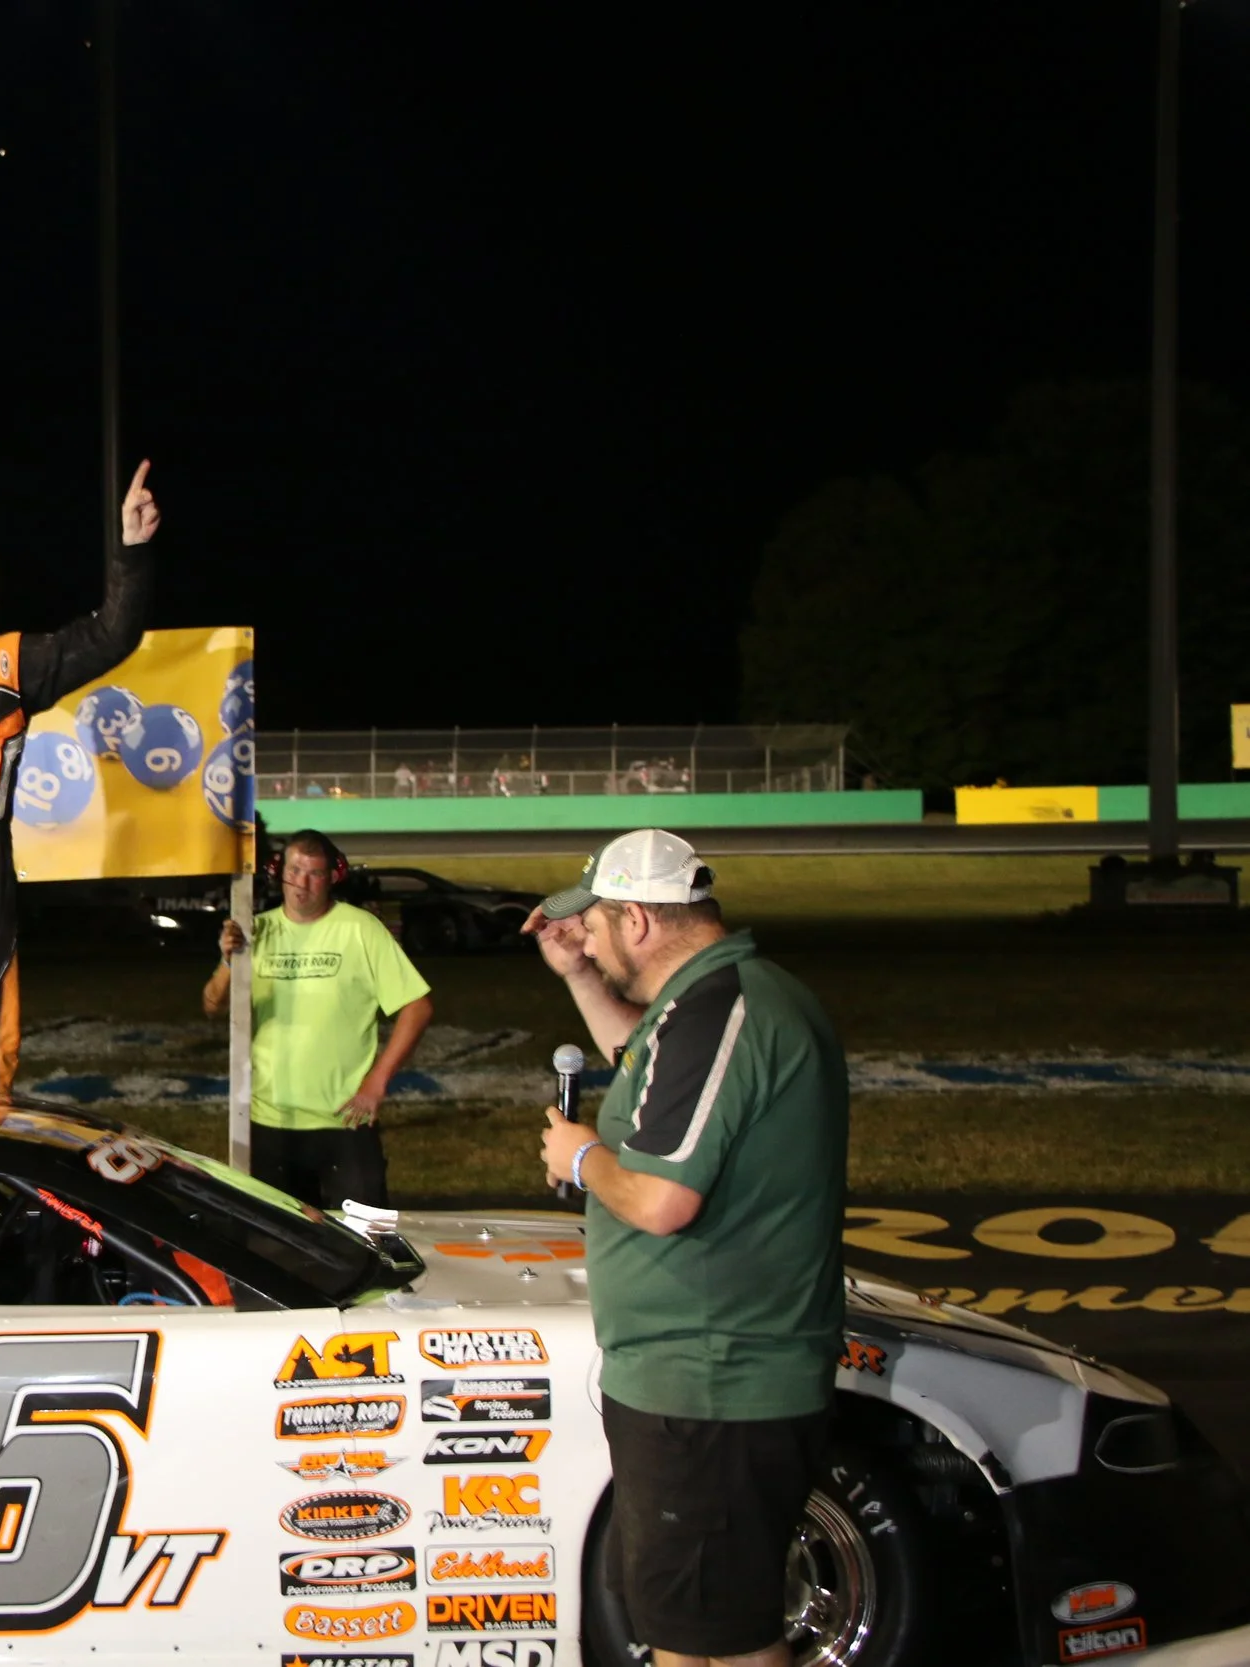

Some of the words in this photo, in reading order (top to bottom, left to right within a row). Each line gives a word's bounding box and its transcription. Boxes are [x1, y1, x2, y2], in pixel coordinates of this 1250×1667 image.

[15, 766, 61, 812] 18
[311, 955, 337, 968] ROAD
[423, 1331, 535, 1354] QUARTER
[442, 1345, 543, 1364] MASTER
[276, 1331, 400, 1381] ACT
[283, 1404, 355, 1427] THUNDER
[356, 1401, 400, 1423] ROAD
[474, 1399, 510, 1411] Racing
[488, 1408, 534, 1419] Products
[427, 1436, 530, 1456] KONI
[443, 1473, 541, 1516] KRC
[297, 1503, 380, 1521] KIRKEY
[424, 1509, 479, 1534] Power
[477, 1508, 552, 1534] Steering
[91, 1532, 226, 1608] VT
[300, 1554, 400, 1579] DRP
[430, 1549, 550, 1581] Edelbrock
[287, 1583, 358, 1596] Performance
[360, 1580, 410, 1593] Products
[295, 1607, 403, 1637] Bassett
[427, 1593, 557, 1629] DRIVEN
[484, 1622, 529, 1630] RACING
[437, 1639, 556, 1667] MSD
[1065, 1627, 1140, 1656] tilton
